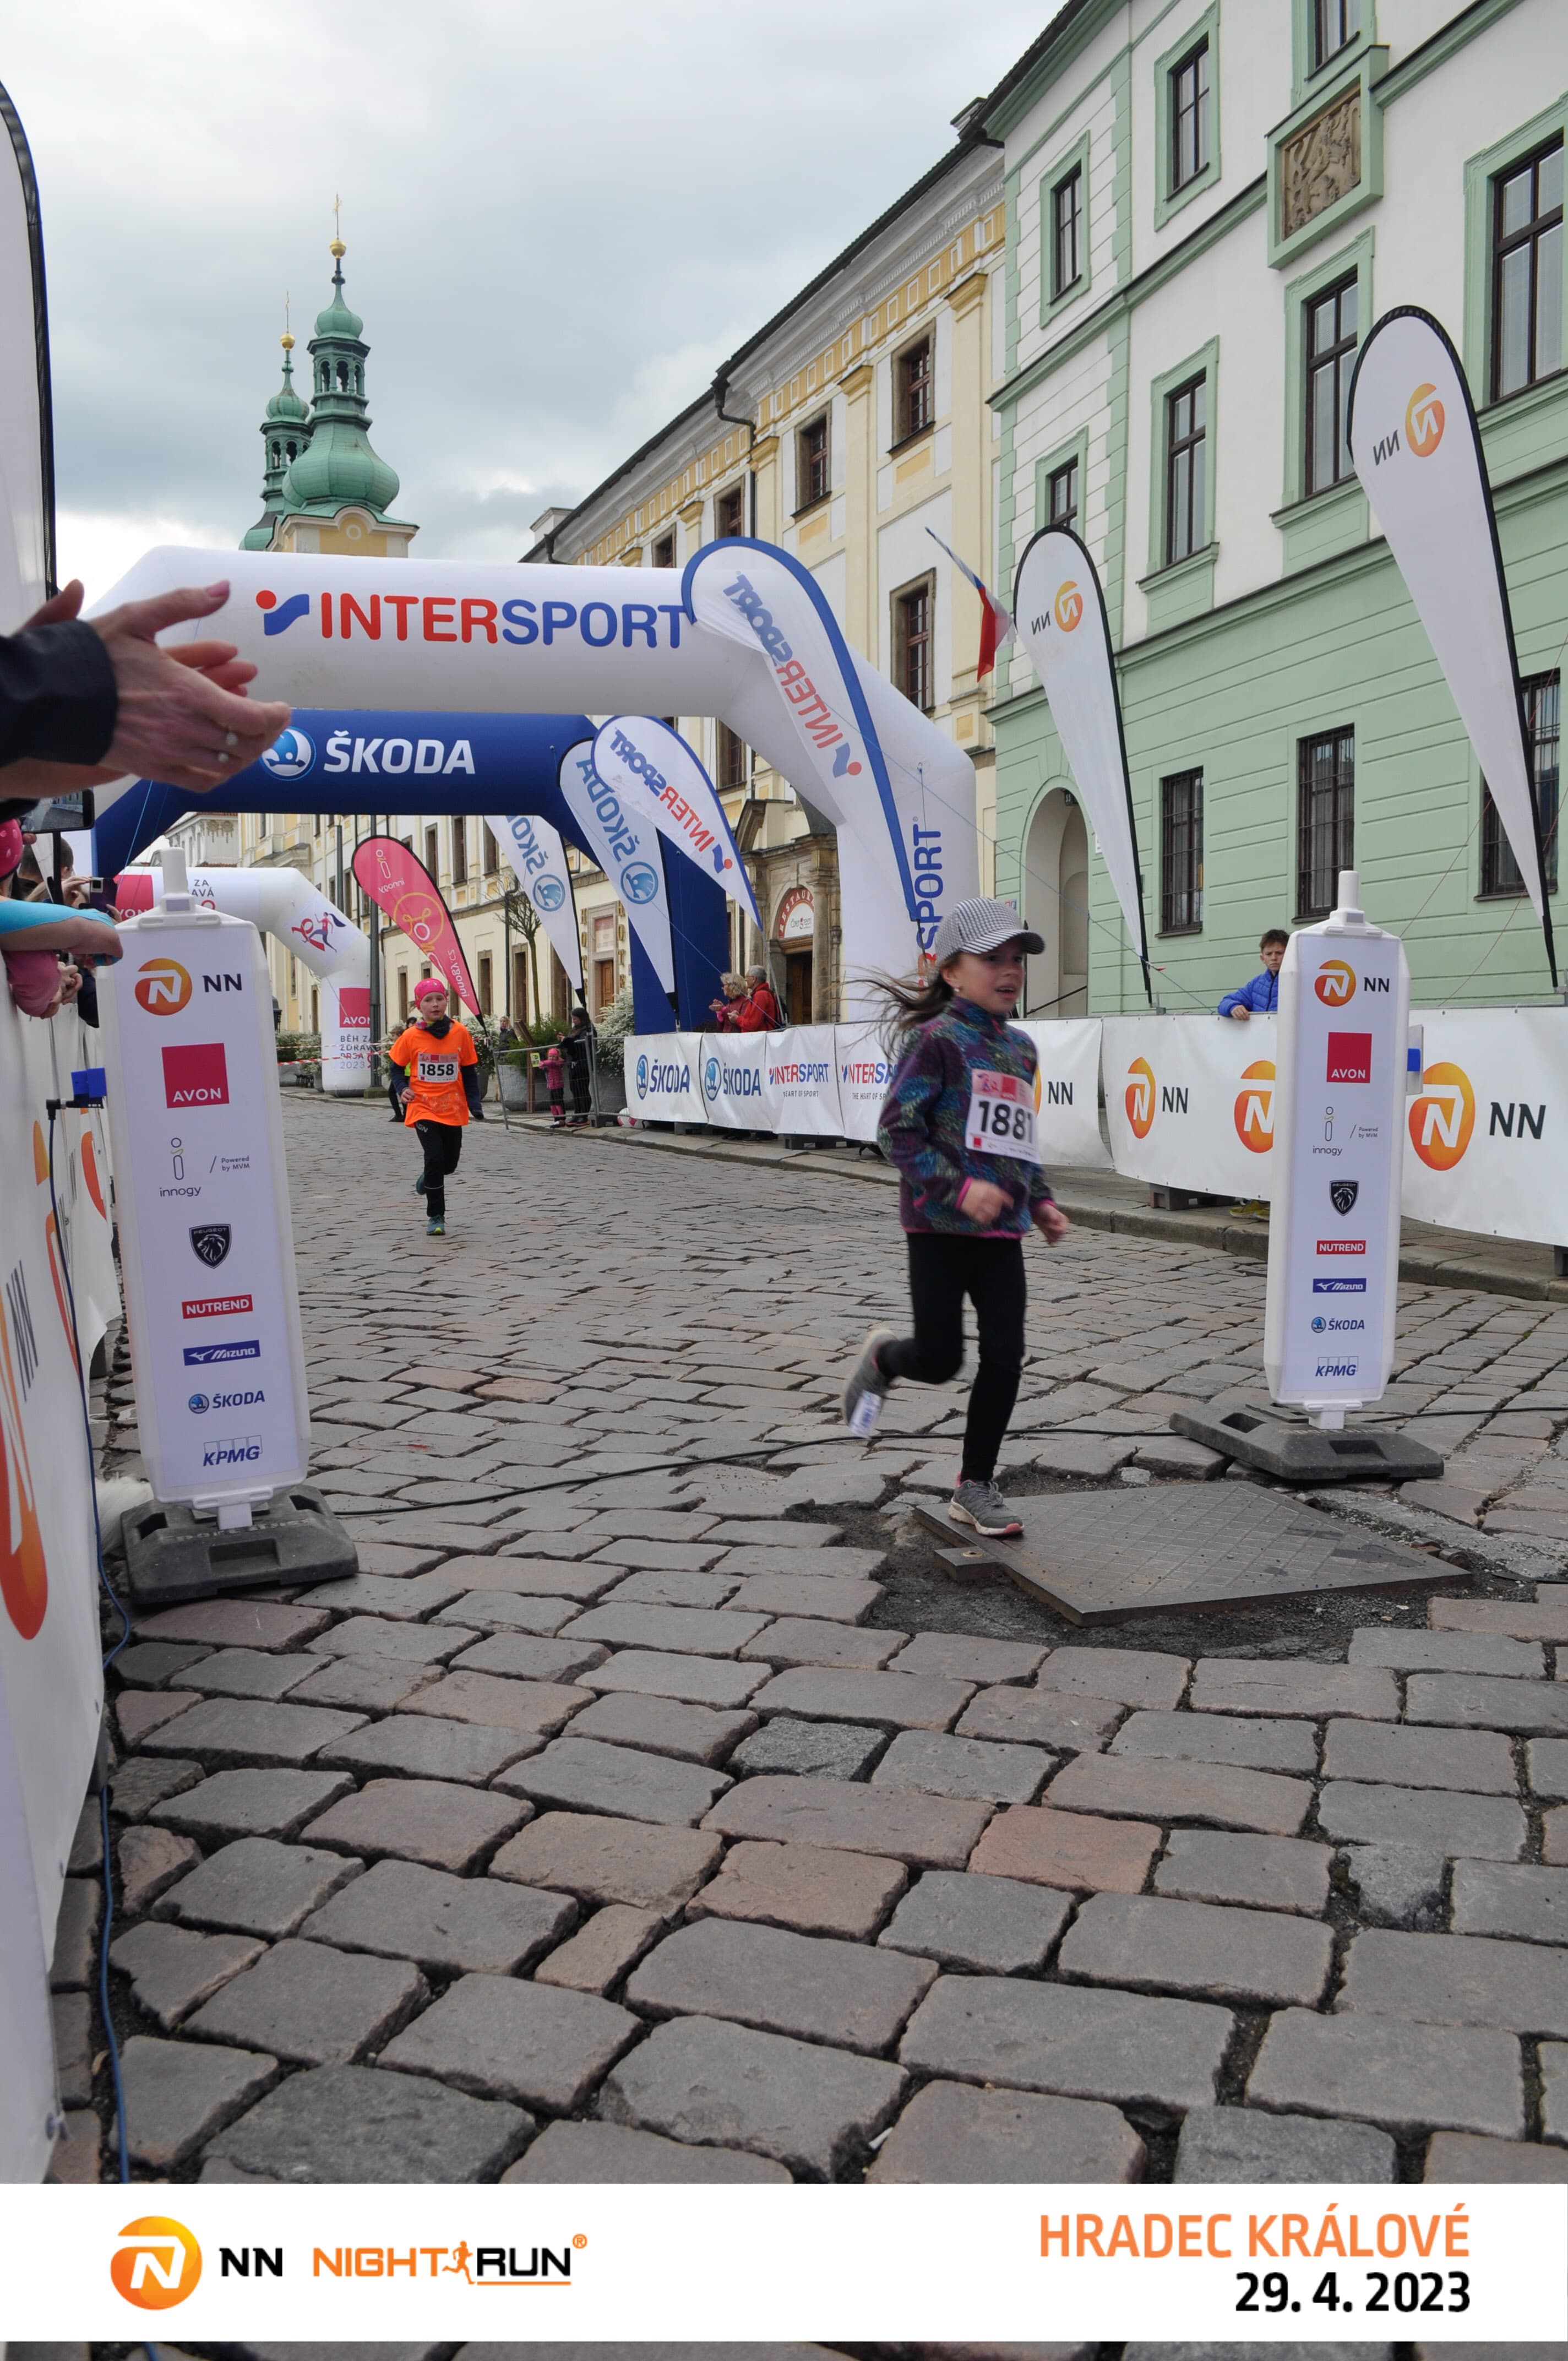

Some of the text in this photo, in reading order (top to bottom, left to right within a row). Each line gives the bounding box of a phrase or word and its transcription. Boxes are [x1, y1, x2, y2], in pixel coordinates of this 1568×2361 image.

[321, 592, 686, 649] INTERSPORT
[324, 730, 476, 775] ŠKODA
[203, 973, 242, 993] NN
[1364, 977, 1390, 992] NN
[420, 1063, 454, 1076] 1858
[649, 1059, 690, 1093] ŠKODA
[775, 1063, 829, 1085] INTERSPORT
[1331, 1068, 1366, 1079] AVON
[723, 1062, 762, 1097] ŠKODA
[173, 1087, 222, 1103] AVON
[1048, 1081, 1073, 1105] NN
[1162, 1086, 1189, 1114] NN
[1489, 1101, 1547, 1140] NN
[1313, 1146, 1343, 1156] innogy
[160, 1185, 202, 1198] innogy
[1319, 1243, 1364, 1252] NUTREND
[186, 1298, 249, 1315] NUTREND
[1328, 1318, 1365, 1331] ŠKODA
[1315, 1364, 1357, 1377] KPMG
[212, 1390, 265, 1409] ŠKODA
[203, 1445, 260, 1467] KPMG
